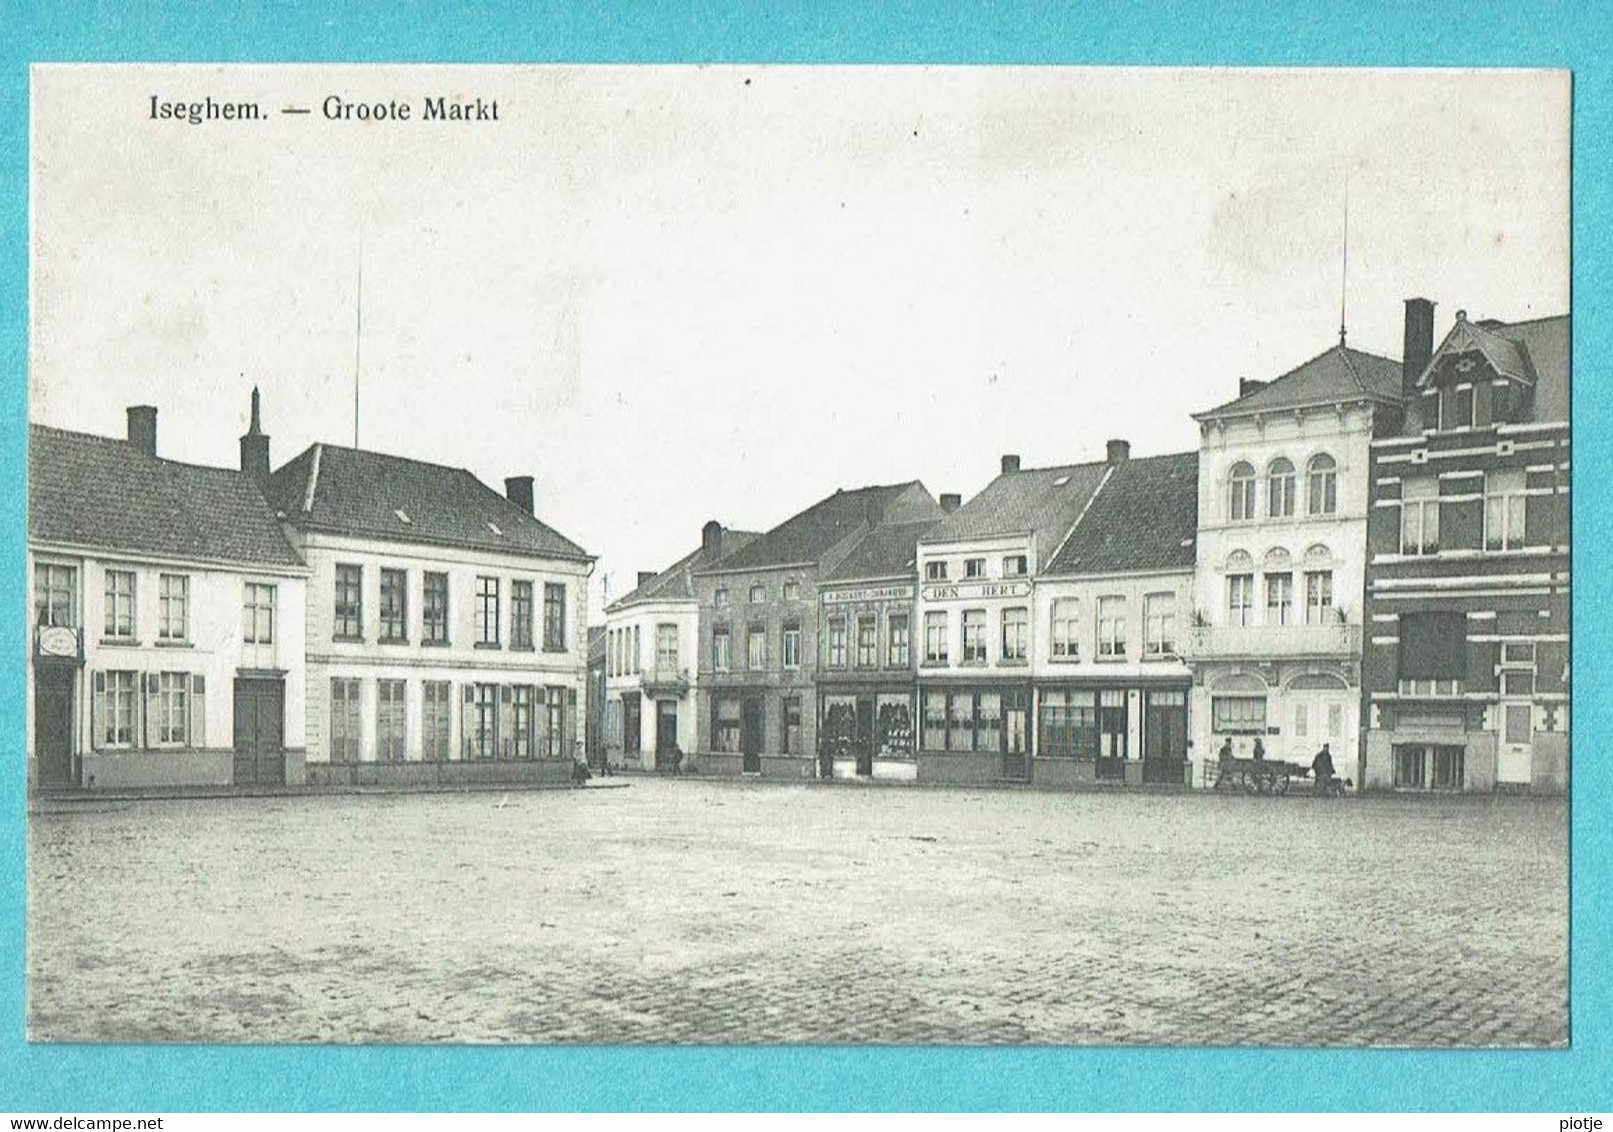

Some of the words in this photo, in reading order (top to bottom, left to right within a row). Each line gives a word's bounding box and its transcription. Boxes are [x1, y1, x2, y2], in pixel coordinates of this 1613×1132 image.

[150, 95, 268, 125] Iseghem.
[322, 96, 411, 121] Groote
[423, 97, 499, 121] Markt
[932, 586, 959, 598] DEN
[982, 584, 1018, 597] HERT
